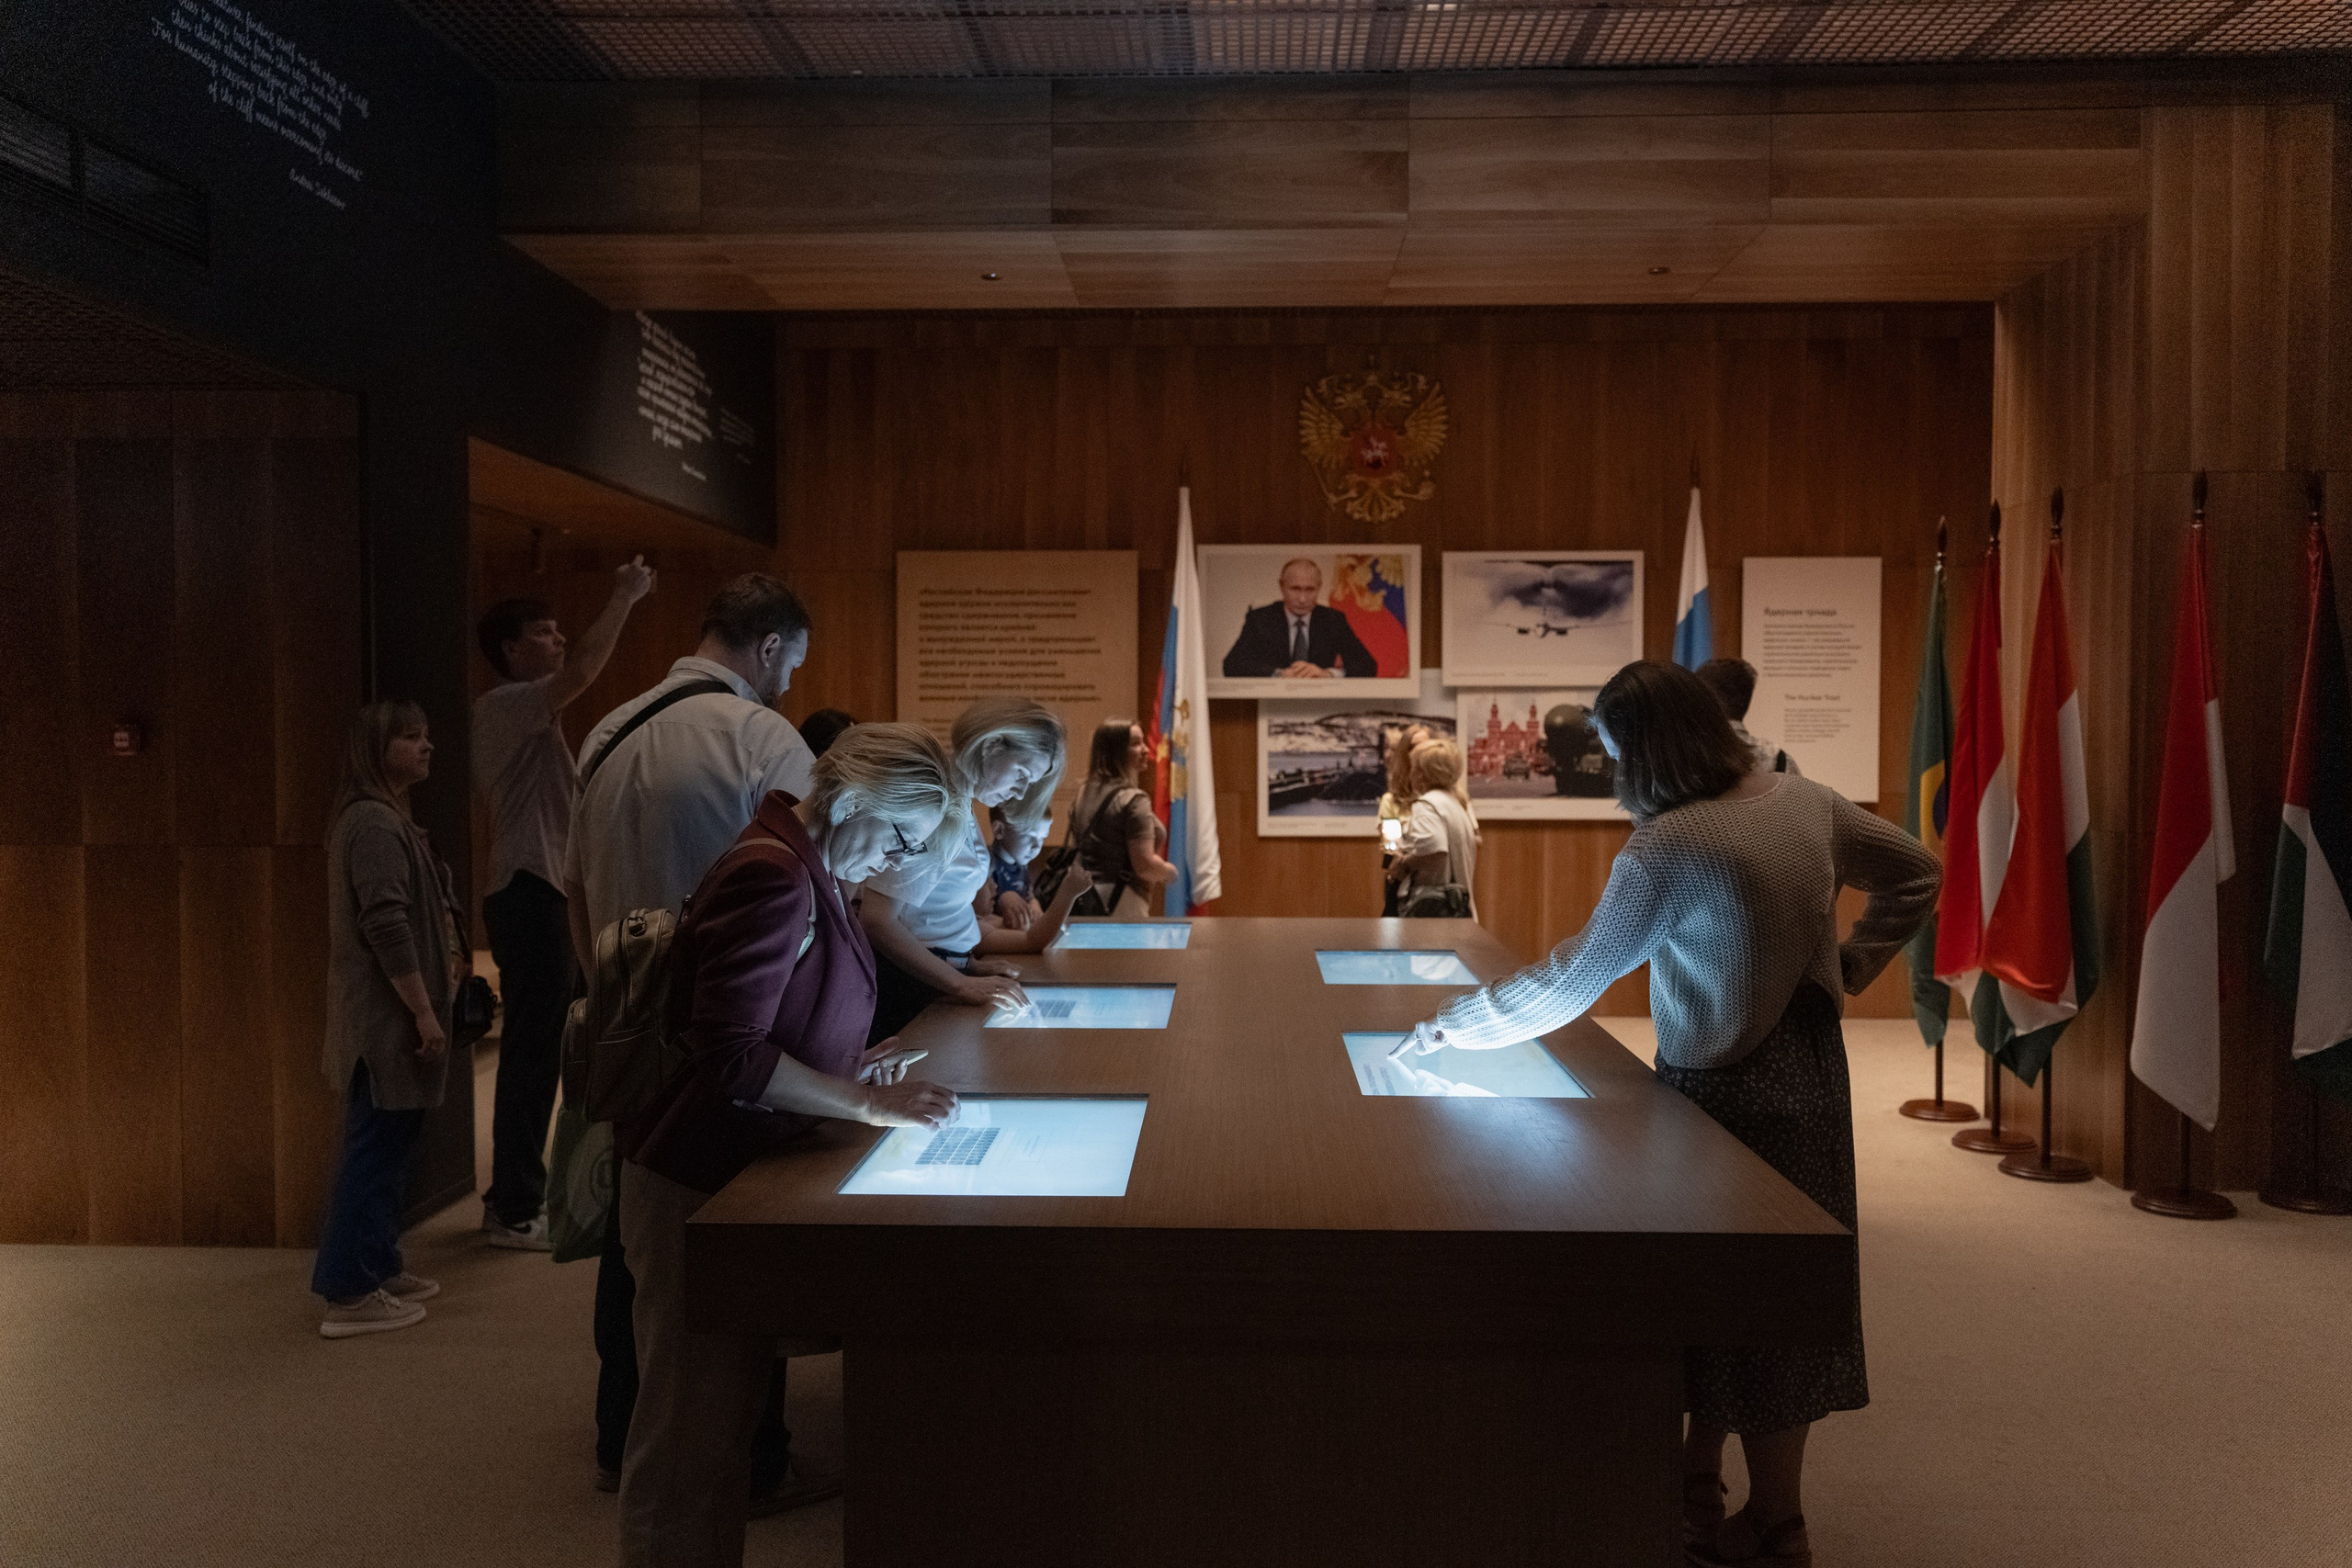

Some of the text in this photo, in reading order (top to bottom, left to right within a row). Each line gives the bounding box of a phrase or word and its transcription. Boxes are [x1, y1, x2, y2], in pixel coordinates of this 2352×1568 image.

[152, 17, 173, 44] For
[209, 80, 218, 103] of
[220, 87, 234, 107] the
[1764, 607, 1803, 617] Ядерная
